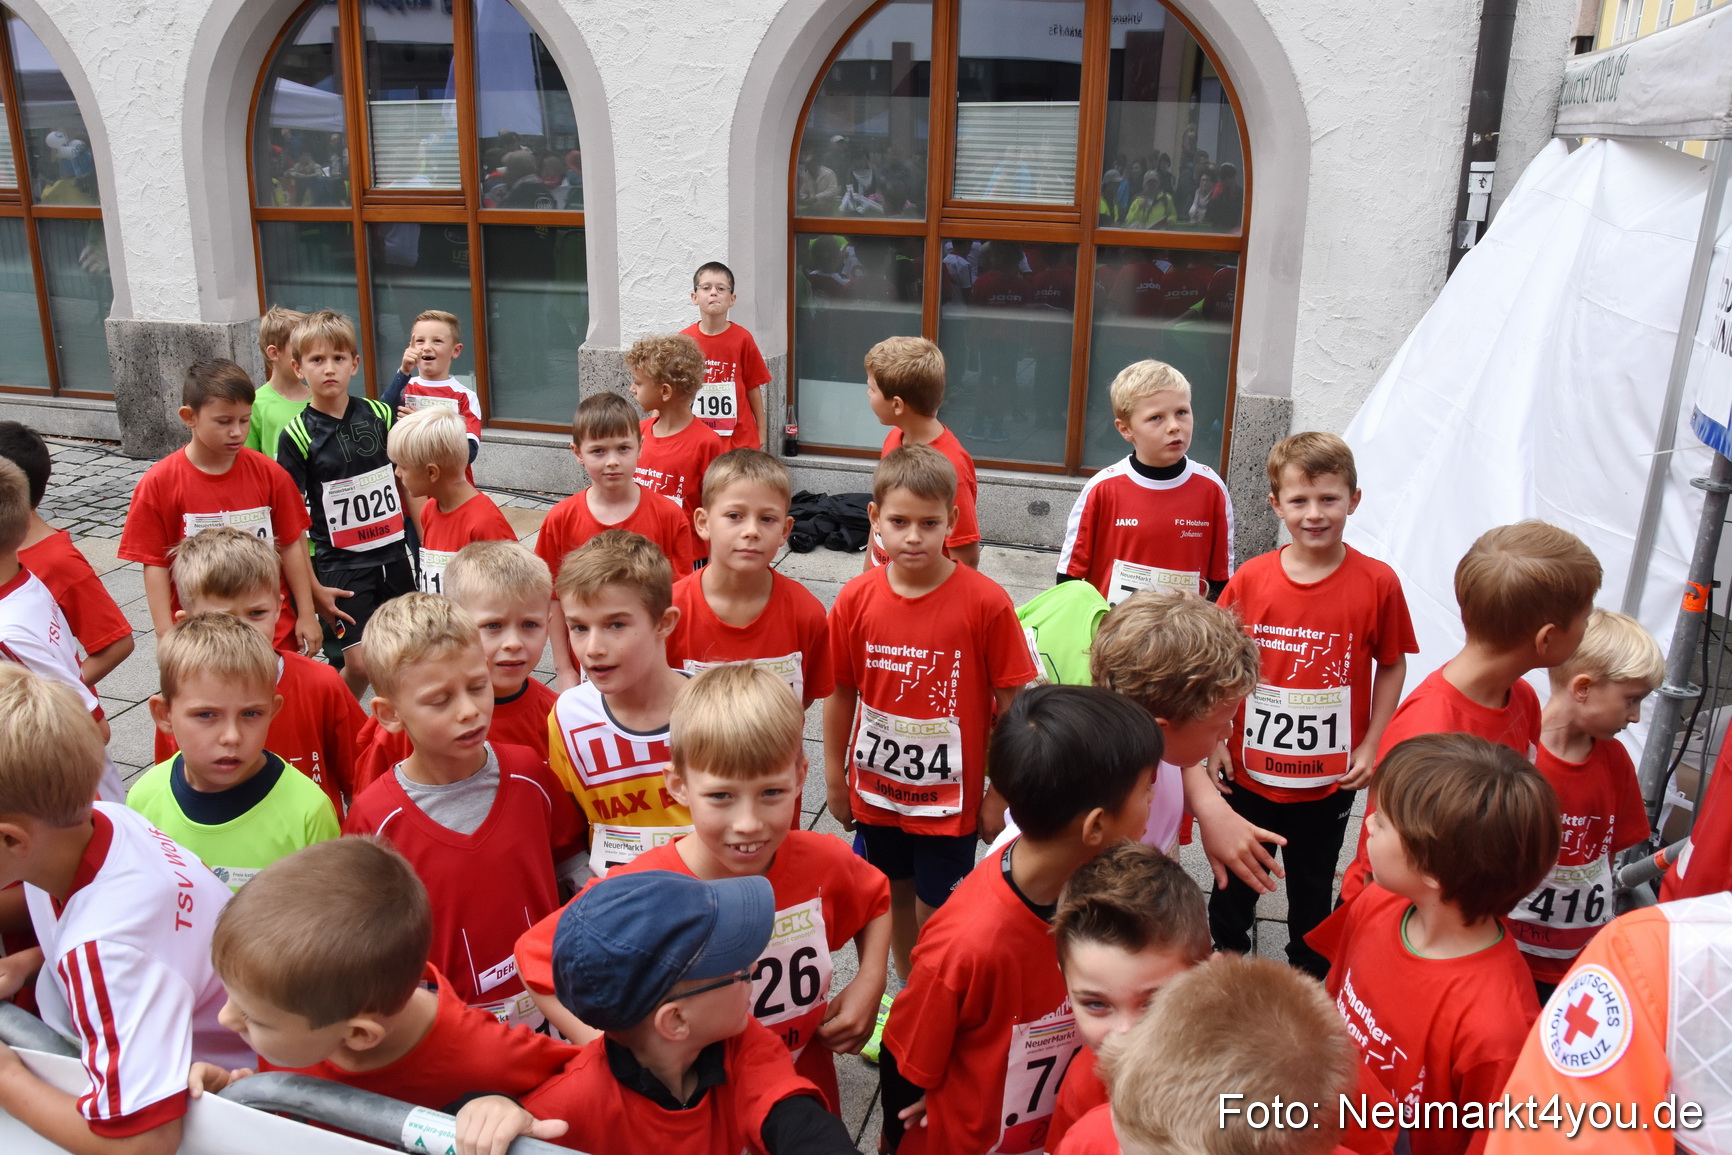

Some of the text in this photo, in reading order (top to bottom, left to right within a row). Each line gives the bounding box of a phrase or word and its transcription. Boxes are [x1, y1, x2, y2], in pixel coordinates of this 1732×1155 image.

[697, 395, 732, 416] 196
[359, 469, 390, 487] BOCK
[635, 467, 664, 479] markter
[333, 485, 397, 526] 7026
[229, 510, 267, 525] BOCK
[1115, 518, 1139, 527] JAKO
[357, 523, 391, 541] Niklas
[1120, 571, 1152, 582] NeuerMarkt
[1158, 572, 1197, 586] BOCK
[1253, 624, 1326, 640] Neumarkter
[866, 640, 930, 659] eumarkter
[866, 658, 914, 676] tadtlauf
[948, 650, 962, 718] BAMBINI
[1288, 691, 1342, 705] BOCK
[895, 719, 950, 735] BOCK
[1255, 708, 1338, 751] 7251
[867, 731, 951, 780] 7234
[1265, 757, 1324, 775] Dominik
[875, 780, 938, 802] Johannes
[603, 840, 644, 852] NeuerMarkt
[148, 827, 194, 932] TSV Wolf
[1528, 884, 1605, 923] 416
[1516, 922, 1550, 942] Phil
[496, 961, 515, 980] DEH
[751, 946, 821, 1018] 26
[1567, 973, 1621, 1028] DEUTSCHES
[1025, 1030, 1076, 1050] NeuerMarkt
[1561, 1037, 1612, 1067] KREUZ
[408, 1121, 457, 1139] www.jura-geba
